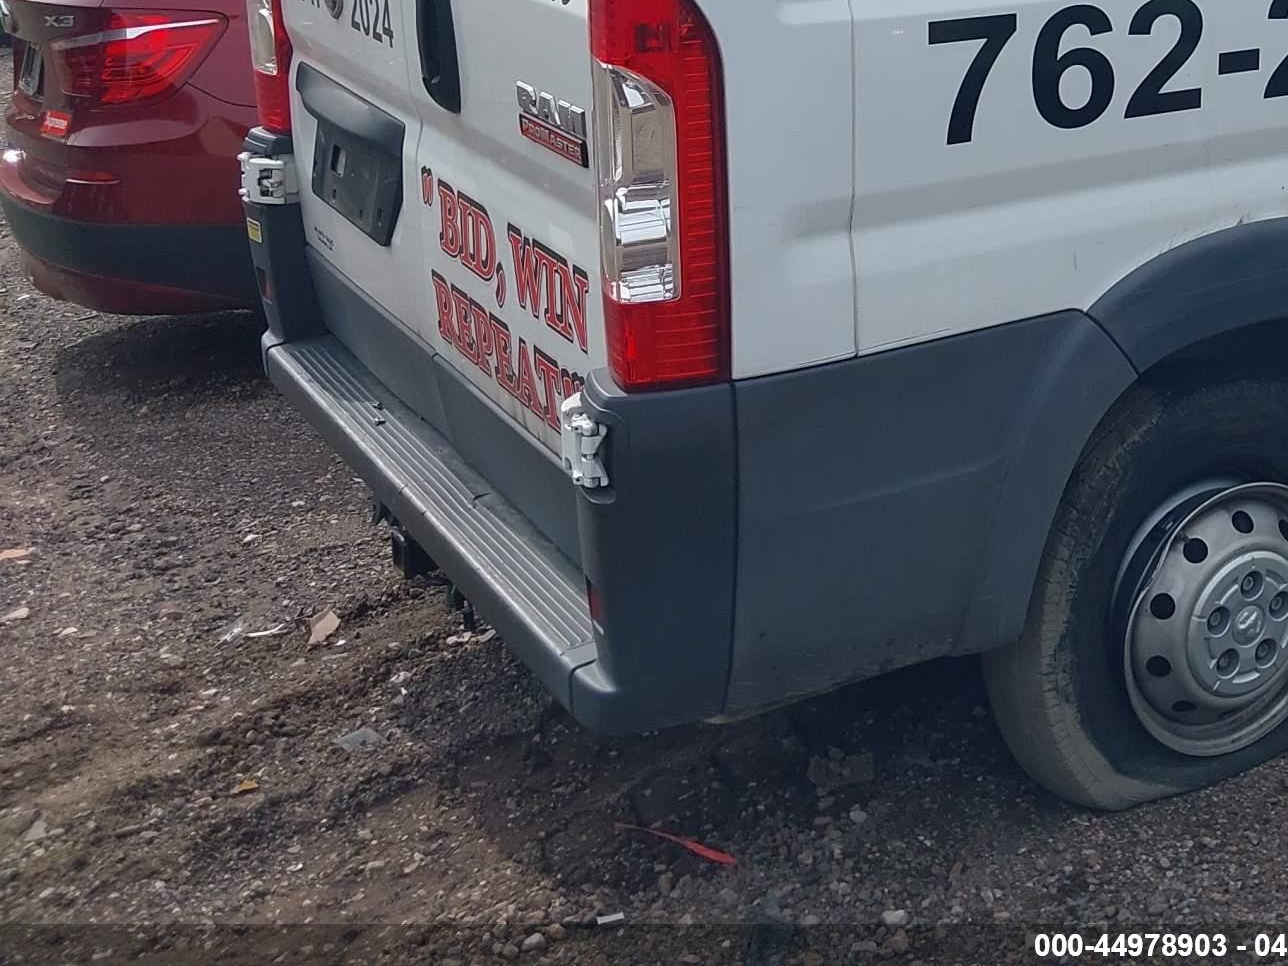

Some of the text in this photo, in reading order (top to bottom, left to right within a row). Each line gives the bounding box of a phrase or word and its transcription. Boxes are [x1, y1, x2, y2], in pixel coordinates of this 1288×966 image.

[44, 15, 75, 27] X3
[516, 80, 587, 139] RAM
[520, 117, 582, 157] PROMASTER
[507, 221, 589, 354] WIN
